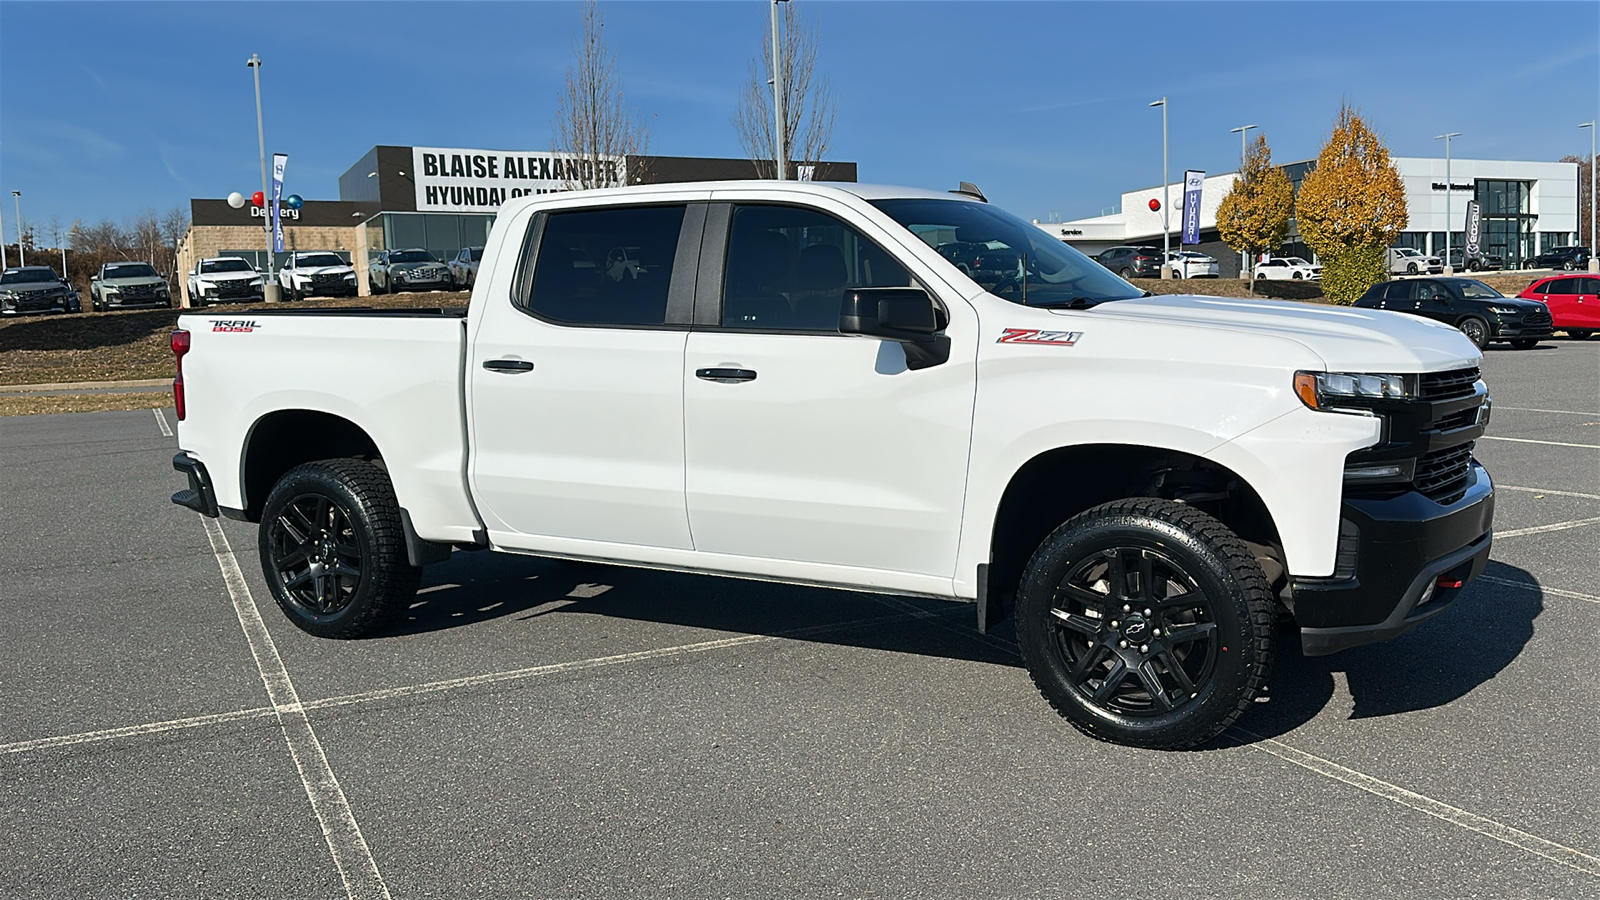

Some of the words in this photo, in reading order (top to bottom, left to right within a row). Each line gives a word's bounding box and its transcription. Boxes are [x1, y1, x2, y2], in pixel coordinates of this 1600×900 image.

[423, 153, 499, 178] BLAISE
[425, 186, 506, 206] HYUNDAI
[251, 206, 299, 220] Deiery
[1188, 193, 1197, 242] HYUNDAI
[996, 328, 1085, 347] Z71
